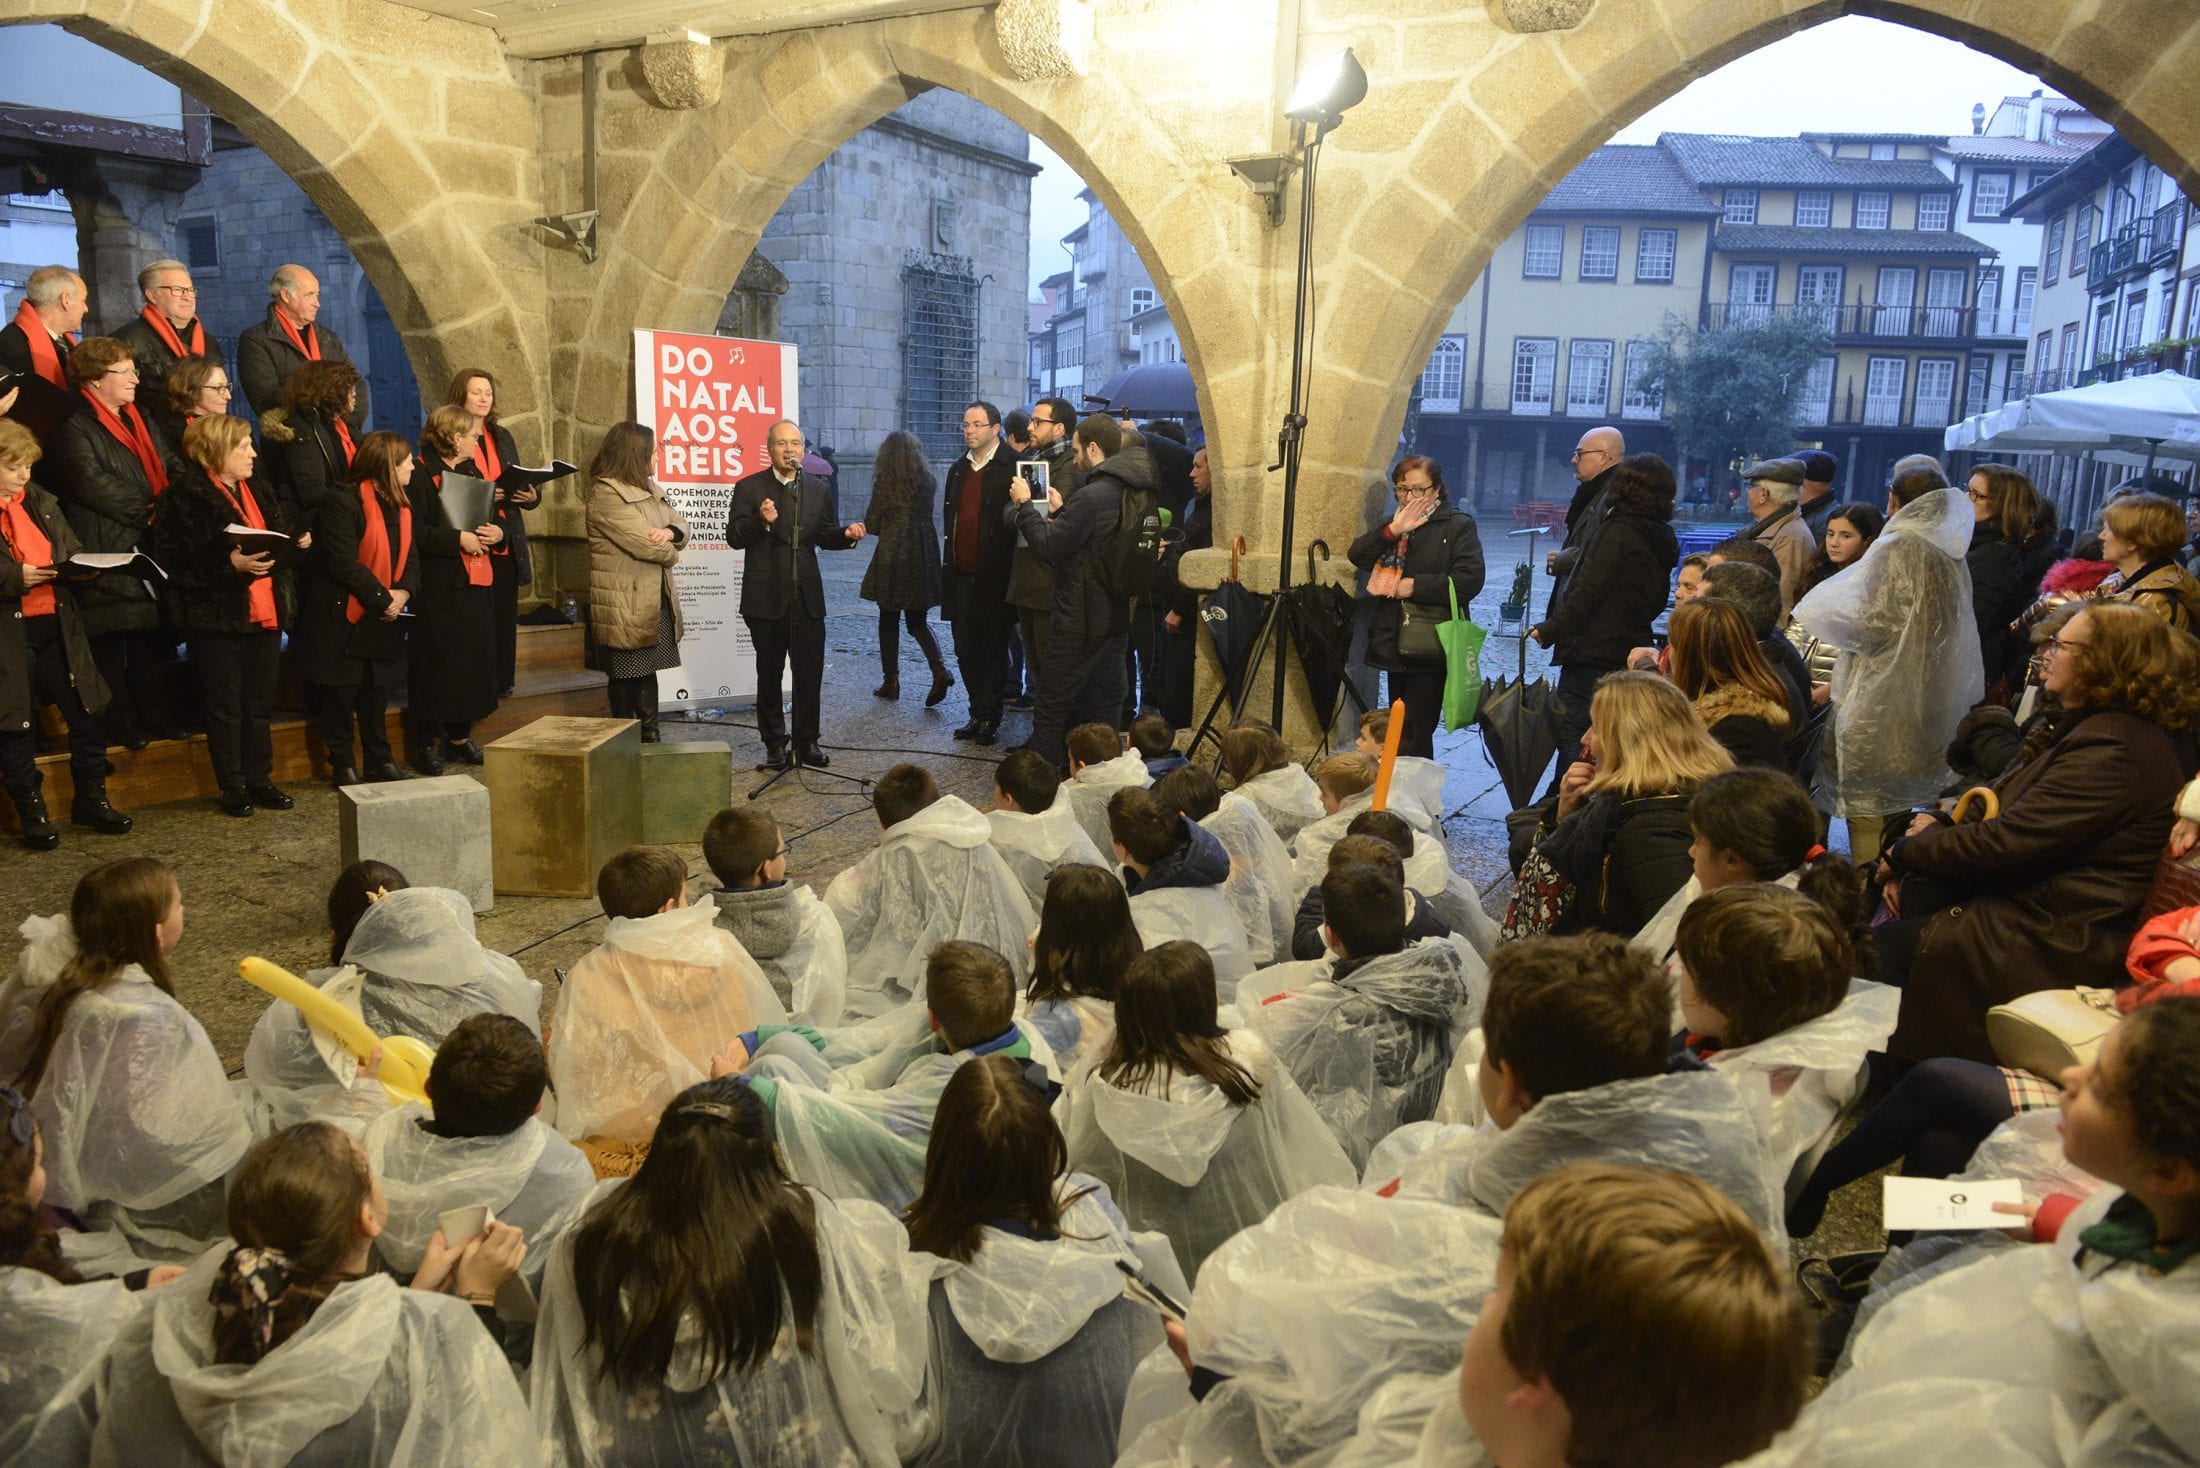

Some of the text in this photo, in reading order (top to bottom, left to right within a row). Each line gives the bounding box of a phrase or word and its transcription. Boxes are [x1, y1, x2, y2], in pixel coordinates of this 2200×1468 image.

[662, 344, 713, 377] DO
[662, 378, 776, 415] NATAL
[662, 412, 738, 444] AOS
[664, 445, 744, 477] REIS
